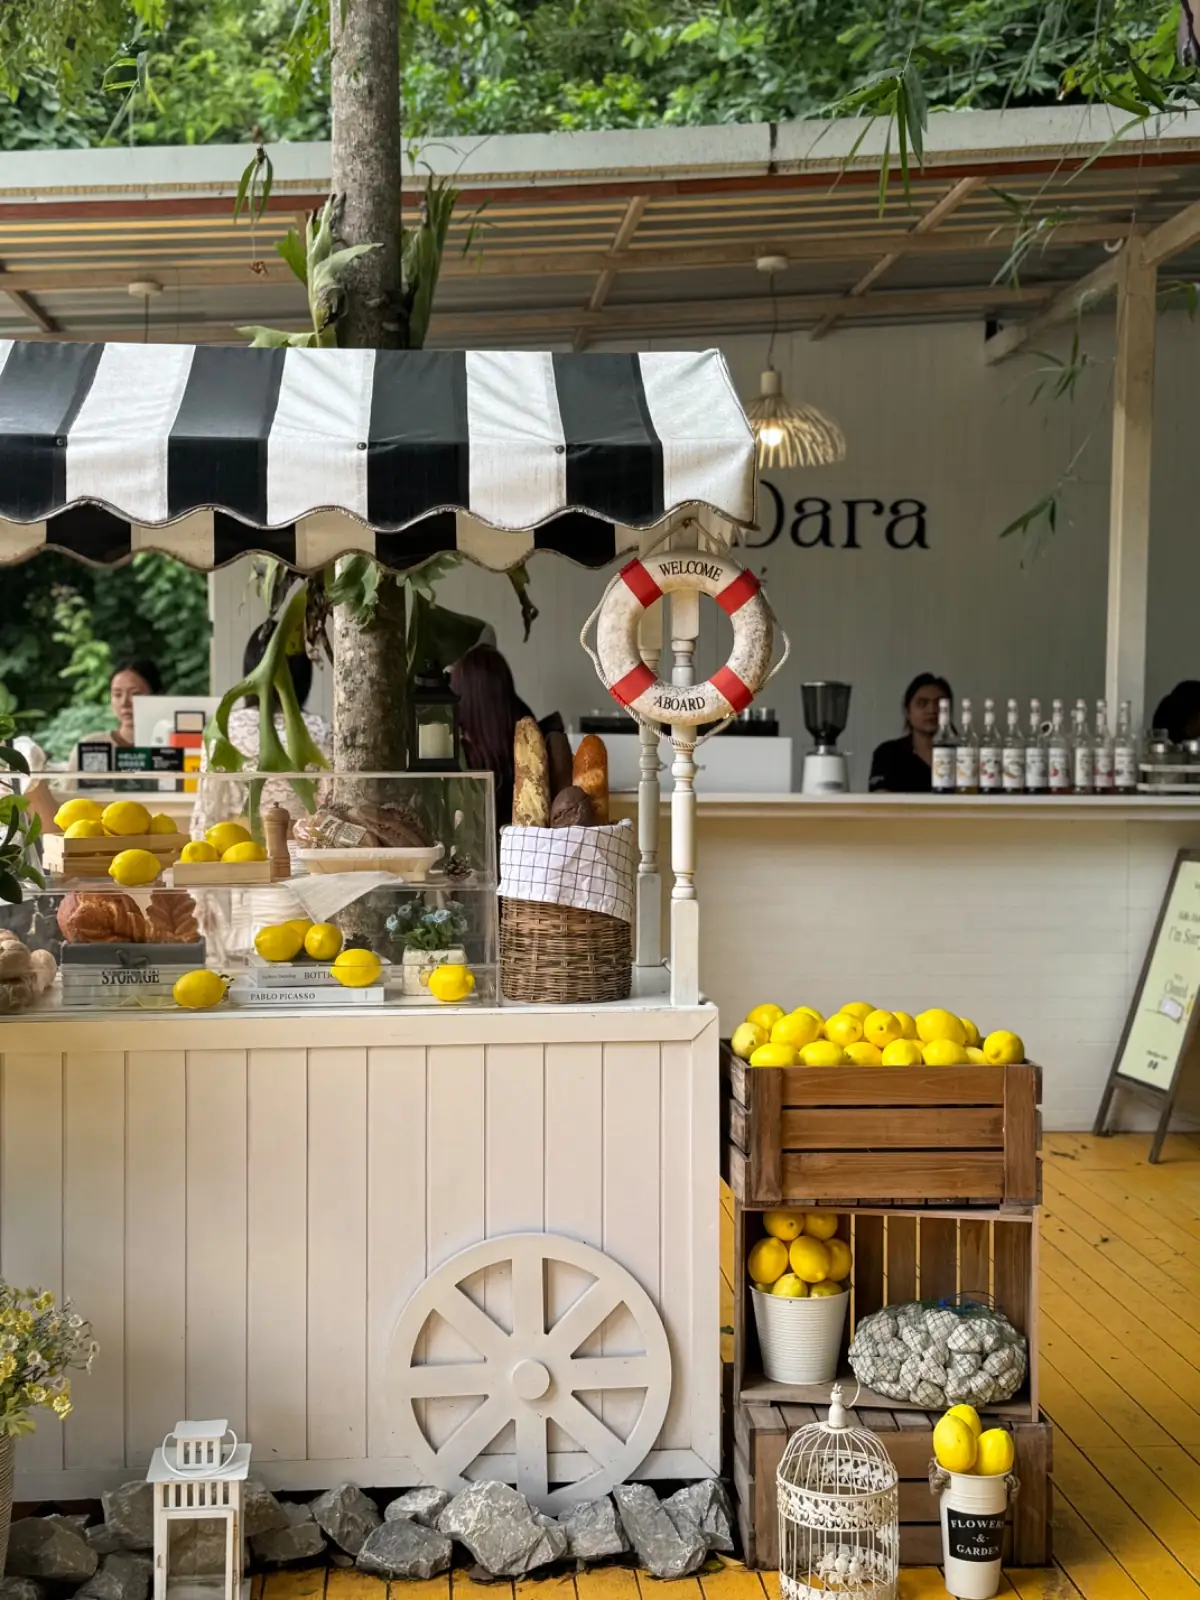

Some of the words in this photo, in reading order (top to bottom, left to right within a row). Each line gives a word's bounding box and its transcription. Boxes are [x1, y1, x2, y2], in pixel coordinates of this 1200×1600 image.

[658, 560, 724, 582] WELCOME
[653, 695, 706, 711] ABOARD
[250, 993, 278, 1001] PABLO
[279, 993, 316, 1001] PICASSO
[950, 1519, 1005, 1529] FLOWER
[956, 1544, 999, 1556] GARDEN
